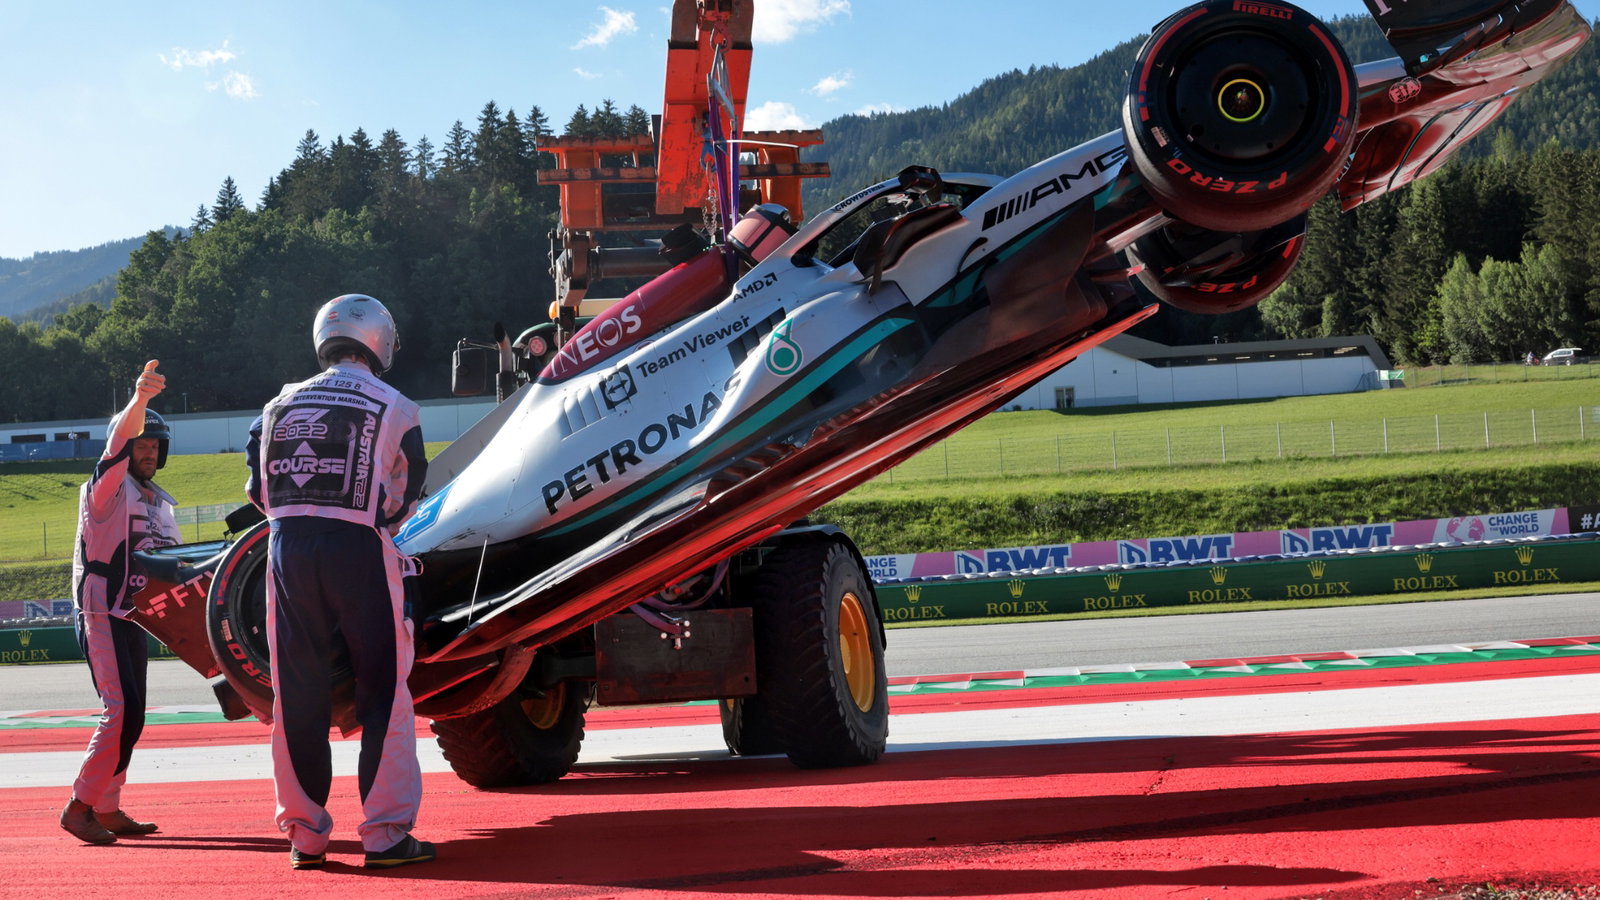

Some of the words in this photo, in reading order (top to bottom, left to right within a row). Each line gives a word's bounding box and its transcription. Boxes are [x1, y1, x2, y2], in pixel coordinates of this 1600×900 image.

[1232, 1, 1294, 20] PIRELLI
[1390, 80, 1419, 102] FIA
[1167, 158, 1260, 194] ZERO
[1268, 171, 1288, 190] P
[733, 281, 765, 304] AMD
[551, 305, 642, 379] INEOS
[636, 315, 751, 378] TeamViewer
[334, 380, 352, 388] 125
[338, 396, 368, 407] MARSHAL
[273, 424, 328, 442] 2022
[540, 371, 742, 516] PETRONAS
[268, 458, 346, 476] COURSE
[1488, 513, 1539, 527] CHANGE
[1500, 524, 1540, 535] WORLD
[1312, 526, 1393, 552] BWT
[1150, 536, 1232, 563] BWT
[987, 547, 1068, 572] BWT
[1393, 575, 1459, 591] ROLEX
[1493, 568, 1560, 584] ROLEX
[1188, 588, 1252, 603] ROLEX
[1286, 582, 1352, 598] ROLEX
[986, 601, 1048, 615] ROLEX
[1083, 594, 1147, 610] ROLEX
[884, 605, 946, 620] ROLEX
[1, 649, 49, 662] ROLEX
